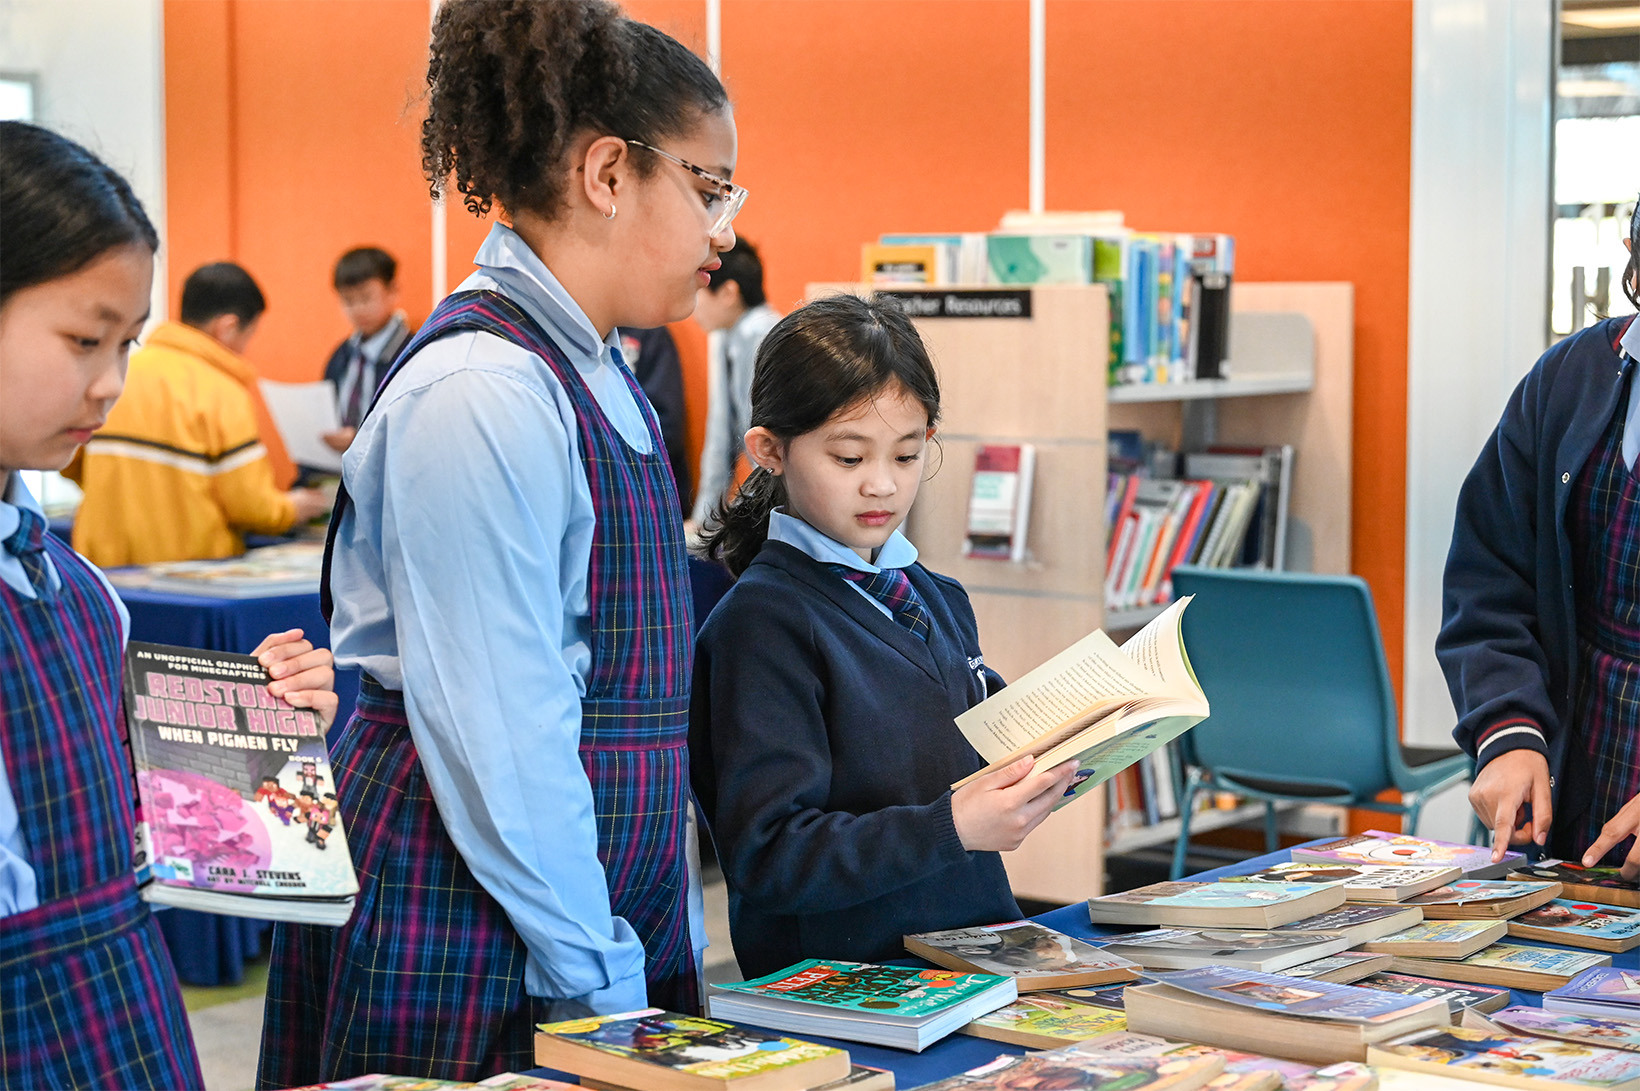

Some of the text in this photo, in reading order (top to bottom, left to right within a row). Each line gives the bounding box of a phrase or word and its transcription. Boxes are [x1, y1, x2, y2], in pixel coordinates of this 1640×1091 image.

[944, 294, 1022, 316] Resources
[137, 651, 152, 659] AN
[154, 653, 212, 667] UNOFFICIAL
[216, 662, 258, 672] GRAPHIC
[168, 663, 189, 672] FOR
[191, 665, 266, 679] MINECRAFTERS
[134, 694, 317, 736] JUNIOR HIGH
[158, 726, 299, 752] WHEN PIGMEN FLY
[288, 755, 315, 763] BOOK
[208, 866, 236, 877] CARA
[256, 870, 301, 880] STEVENS
[767, 971, 827, 991] PETS
